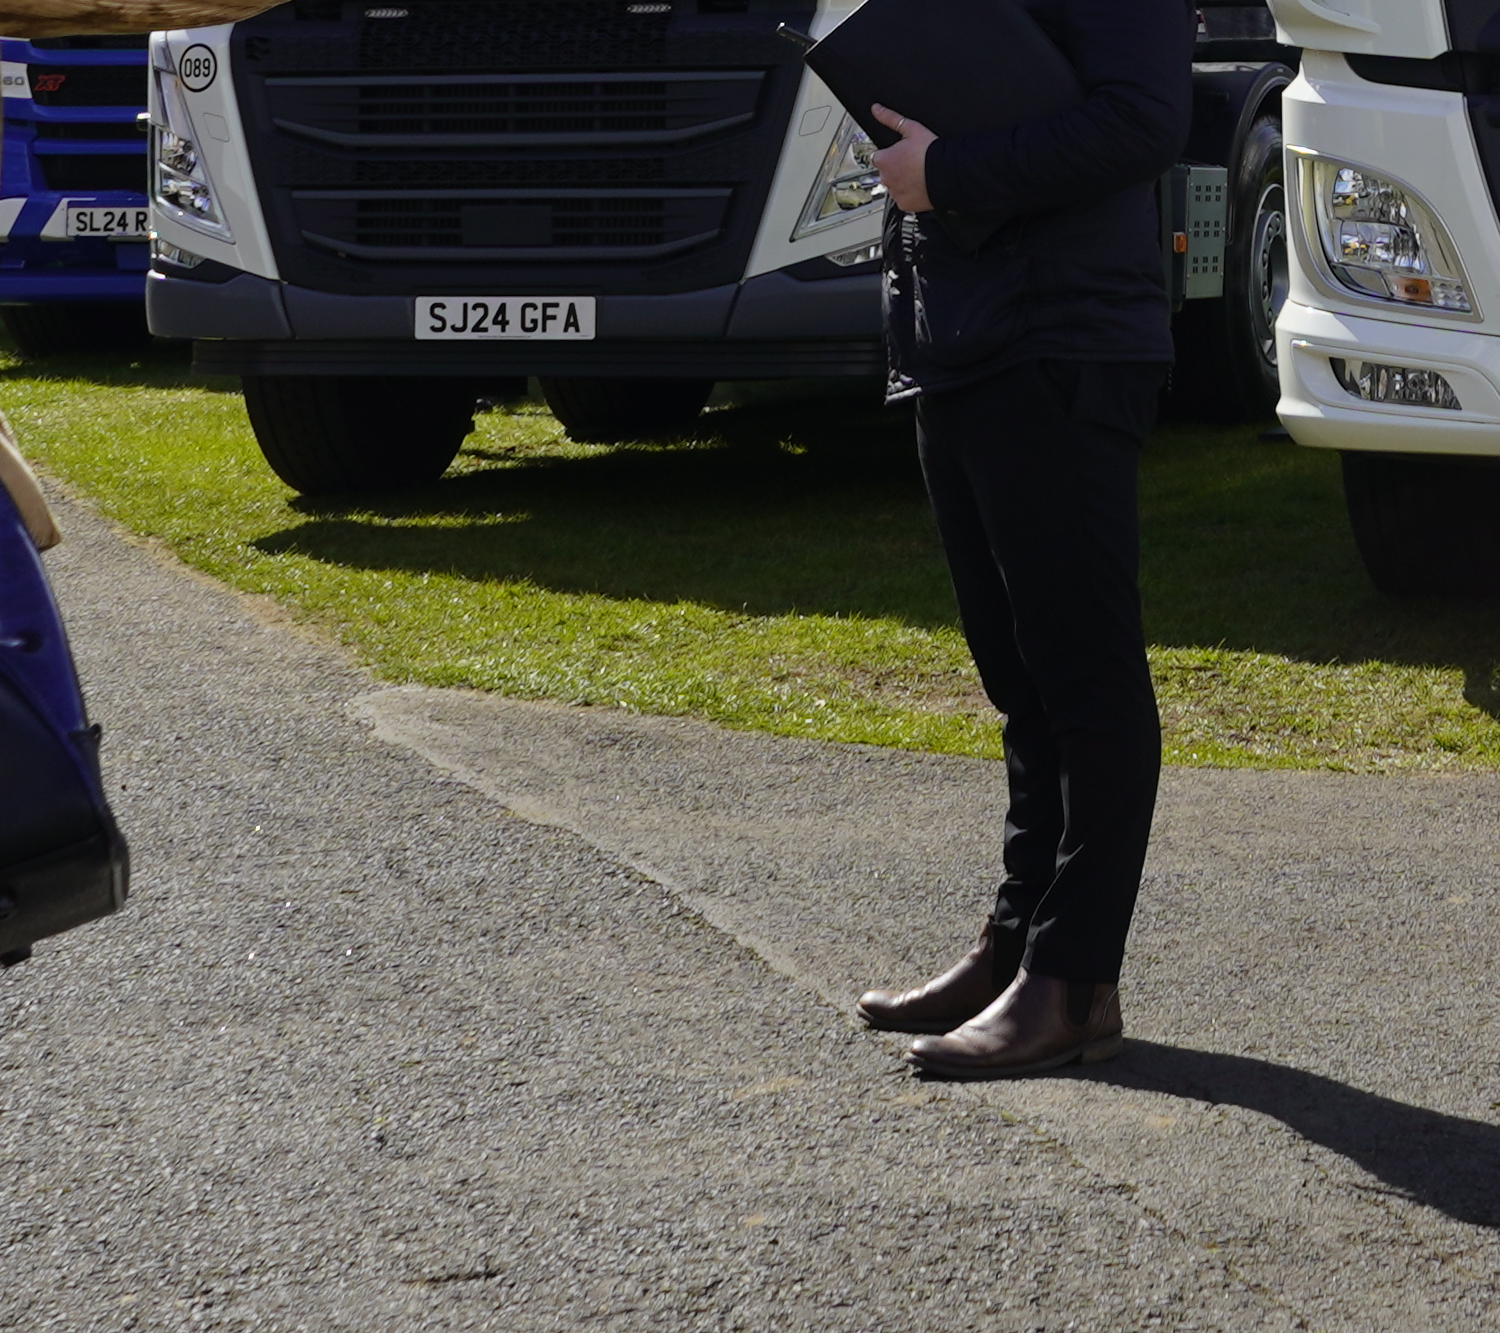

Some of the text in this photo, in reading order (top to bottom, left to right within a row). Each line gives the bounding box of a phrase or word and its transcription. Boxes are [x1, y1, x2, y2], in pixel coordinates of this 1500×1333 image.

[184, 58, 211, 78] 089
[76, 211, 129, 232] SL24
[429, 302, 580, 333] SJ24 GFA
